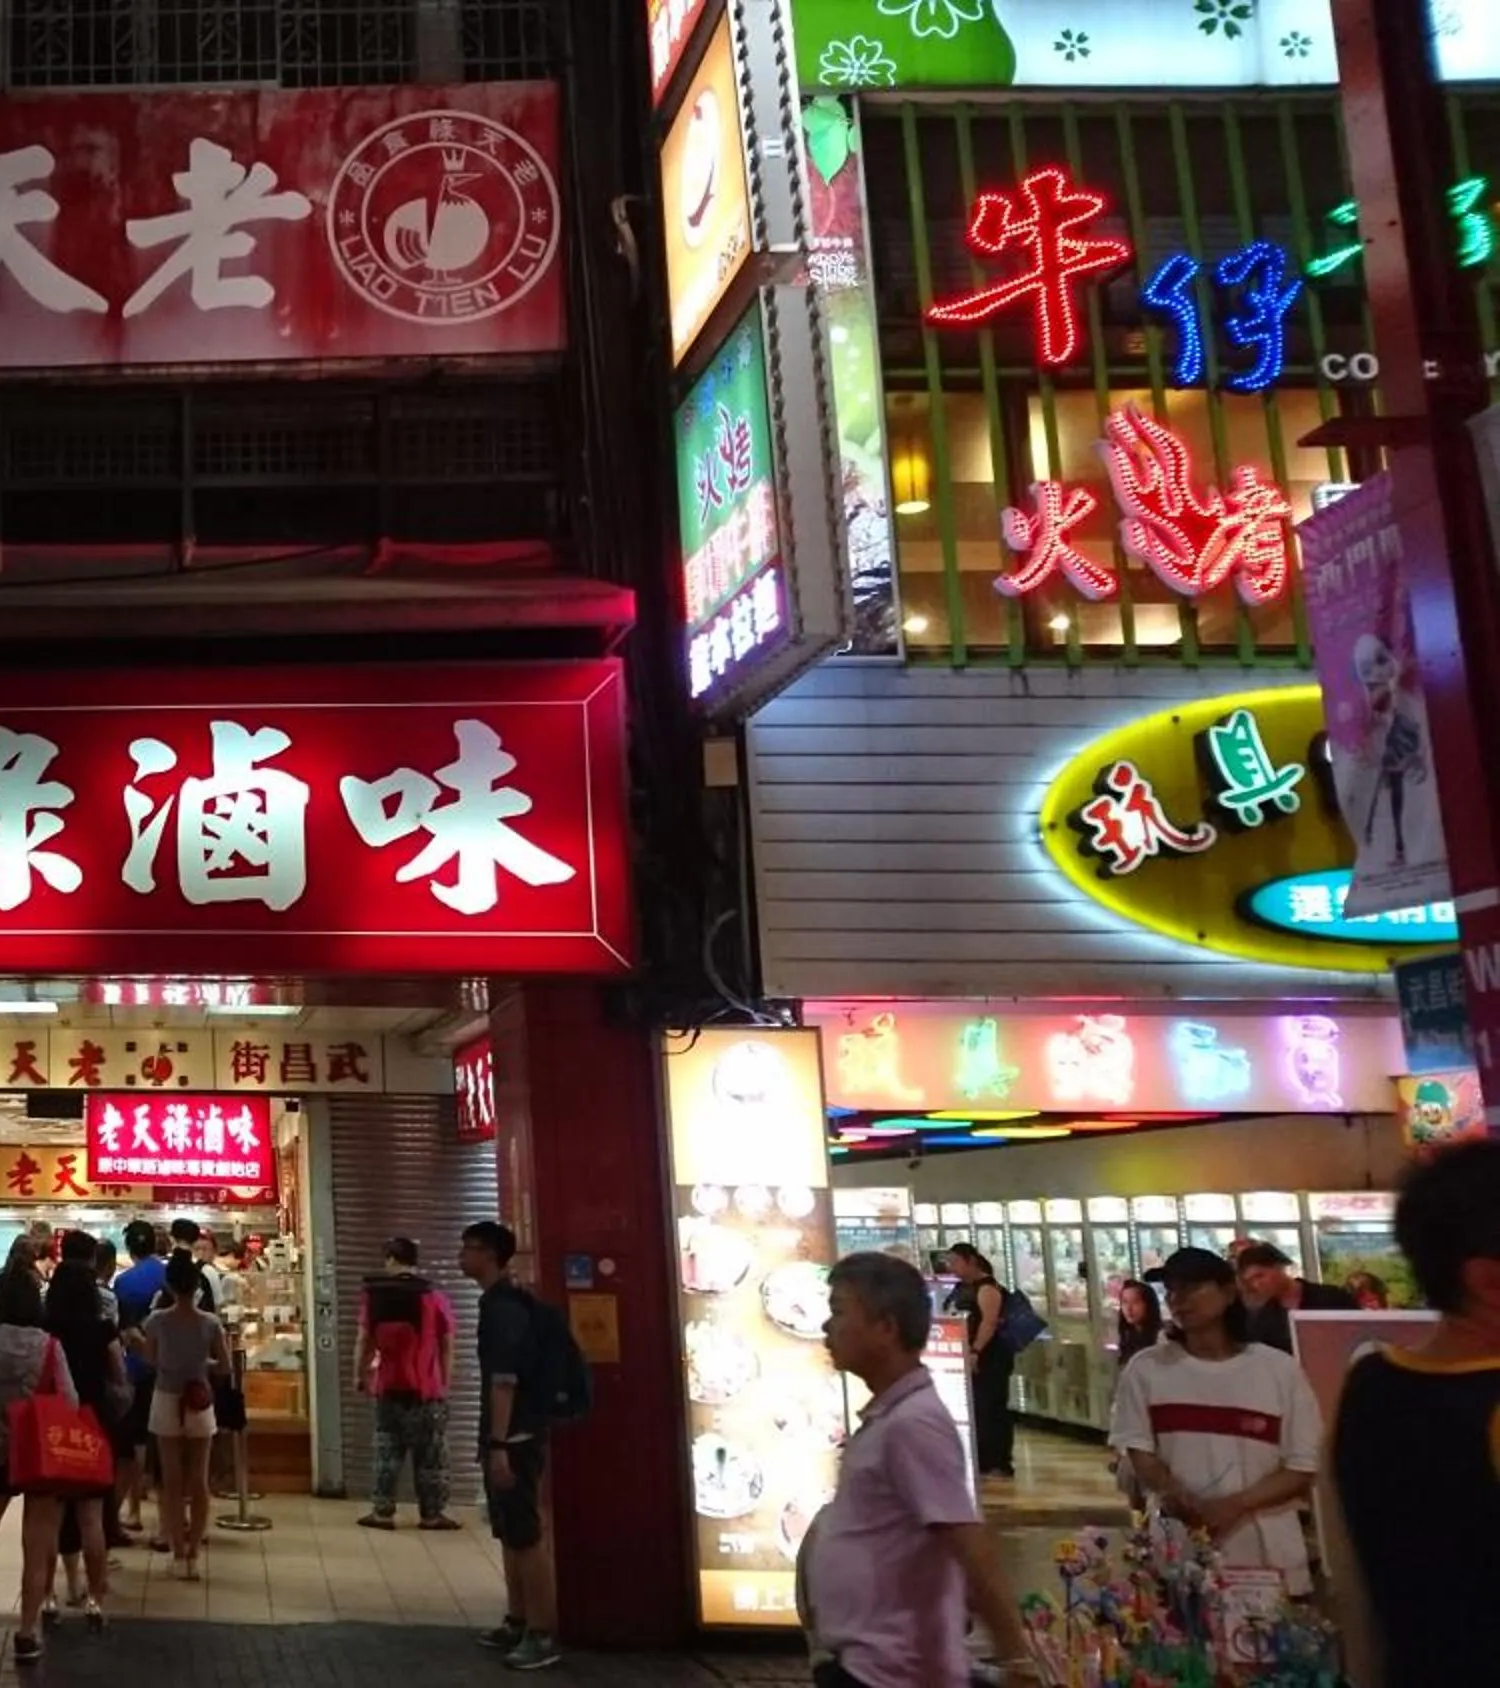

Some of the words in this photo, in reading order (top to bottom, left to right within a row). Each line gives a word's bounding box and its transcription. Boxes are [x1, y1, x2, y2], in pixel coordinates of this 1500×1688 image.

[414, 281, 501, 317] TIEN
[507, 233, 547, 282] LU
[1081, 710, 1306, 875] 玩具
[97, 1103, 260, 1154] 老天祿滷味
